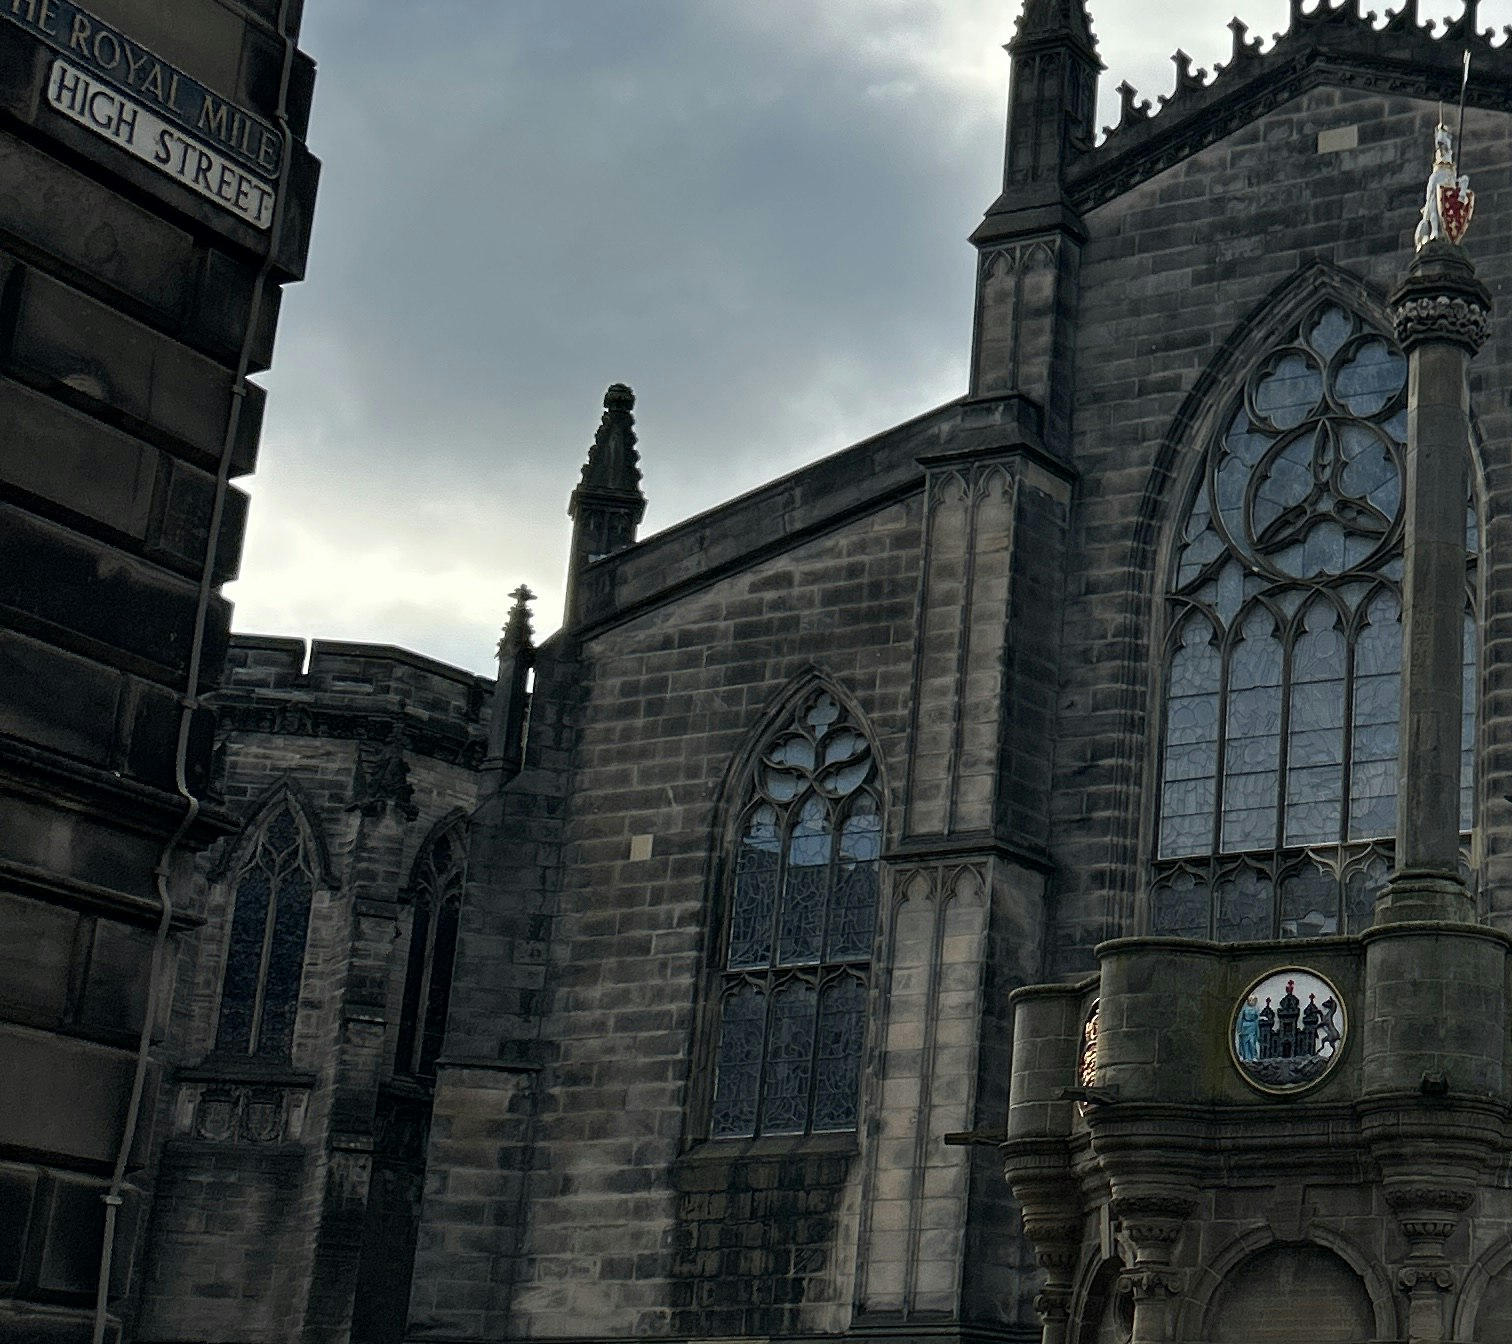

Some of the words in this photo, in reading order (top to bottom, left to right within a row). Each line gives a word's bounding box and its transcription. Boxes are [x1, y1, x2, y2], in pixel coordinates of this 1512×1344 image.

[53, 66, 139, 145] HIGH
[154, 128, 273, 222] STREET
[68, 13, 181, 113] ROYAL
[198, 94, 278, 170] MILE
